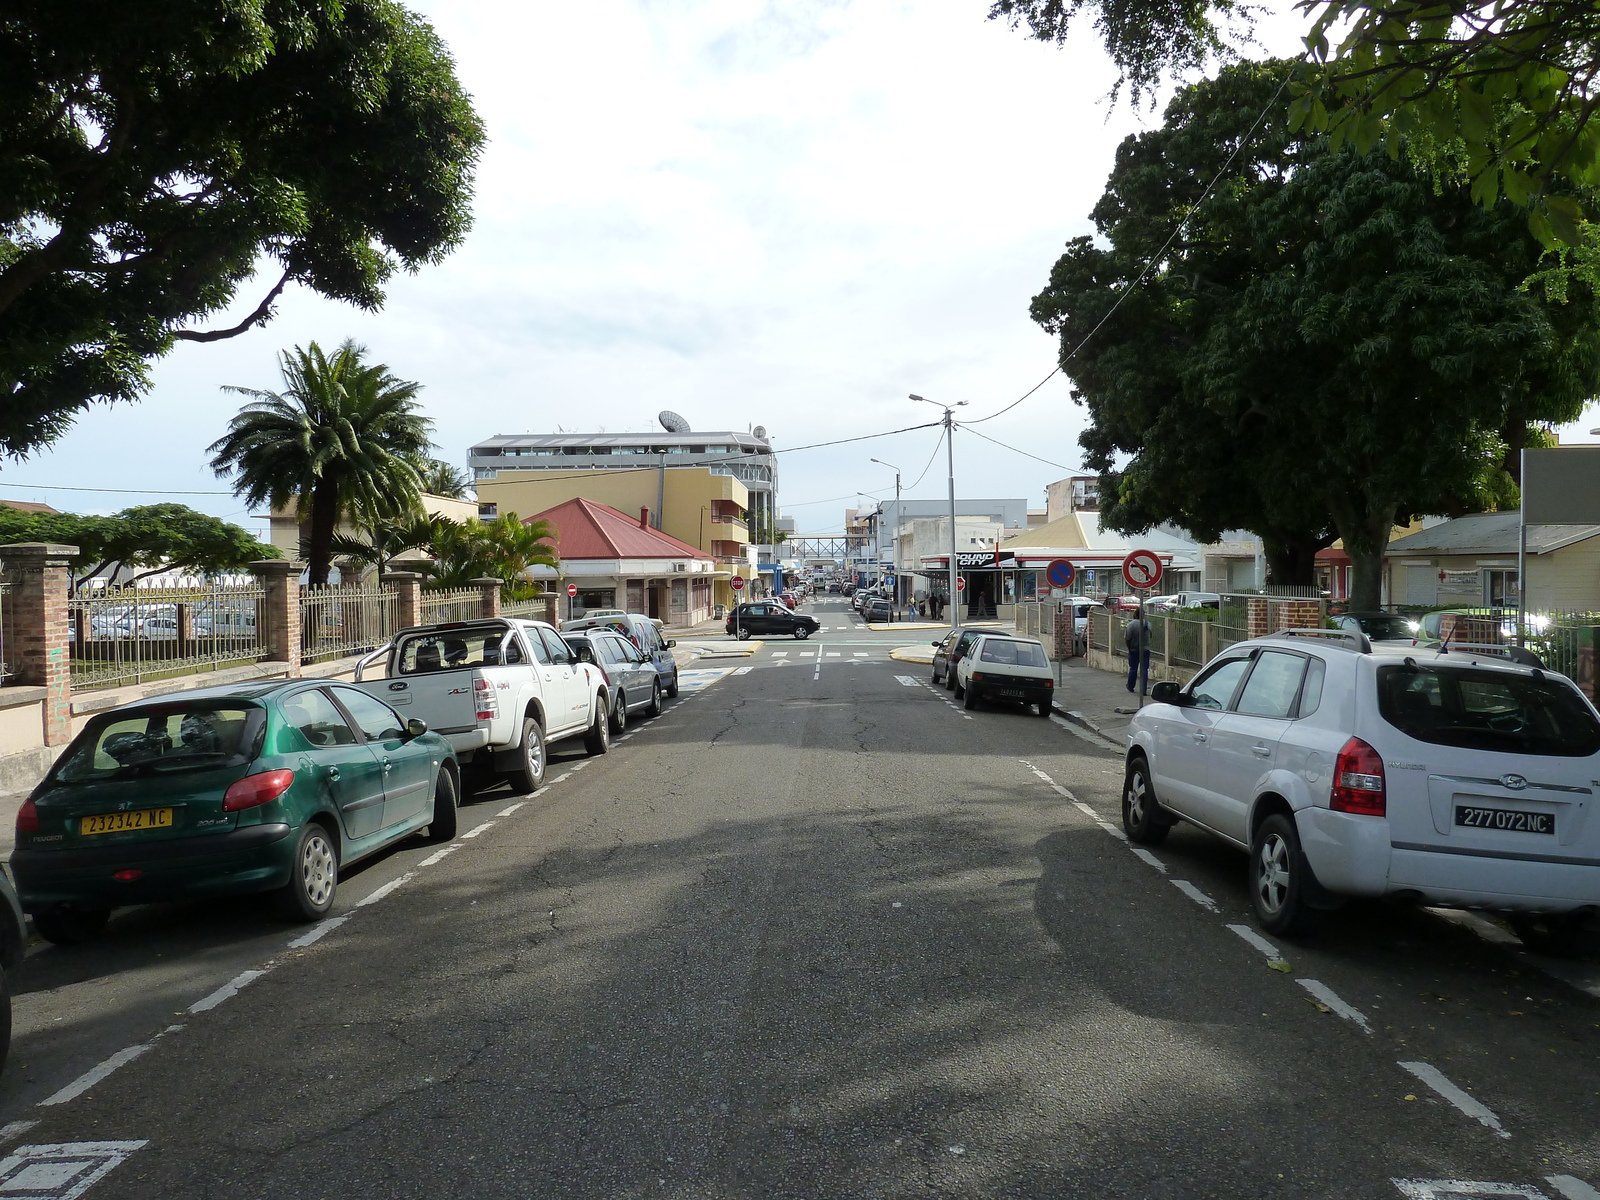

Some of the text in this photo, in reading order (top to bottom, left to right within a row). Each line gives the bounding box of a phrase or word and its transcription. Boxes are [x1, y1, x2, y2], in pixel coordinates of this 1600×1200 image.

[1388, 761, 1427, 772] HYUNDAI
[89, 810, 166, 832] 232342 NC
[196, 819, 215, 827] 206
[33, 835, 64, 843] PEUGEOT
